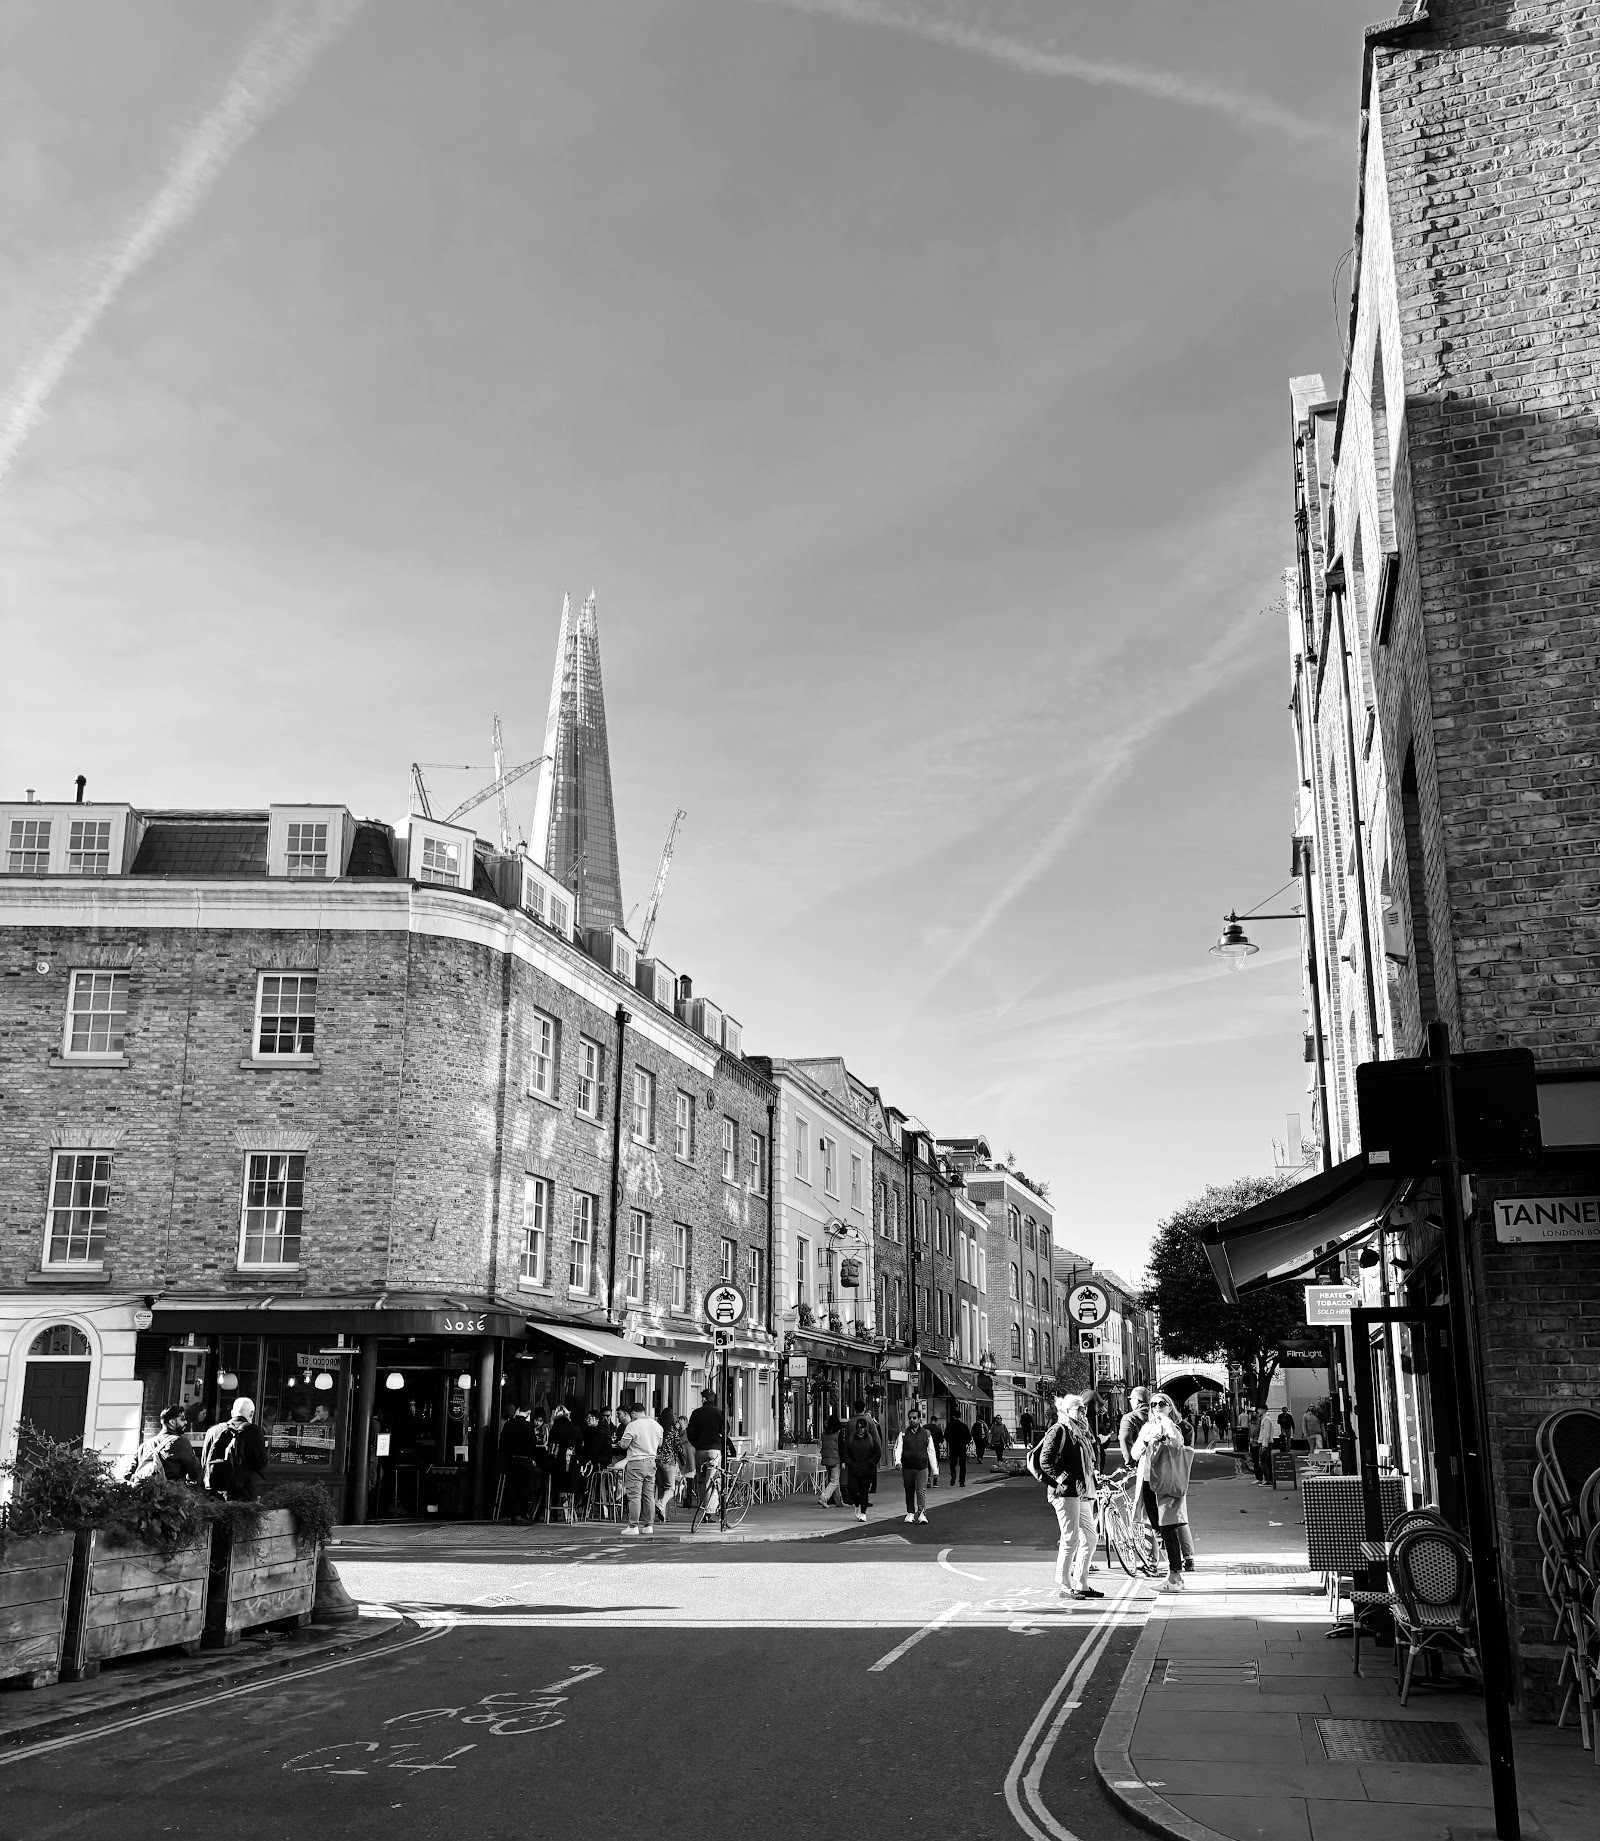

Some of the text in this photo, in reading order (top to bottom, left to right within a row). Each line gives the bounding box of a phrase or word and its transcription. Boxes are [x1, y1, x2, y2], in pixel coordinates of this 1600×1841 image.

[1500, 1202, 1600, 1226] TANNE
[1542, 1229, 1584, 1237] LONDON
[444, 1313, 488, 1331] JOSÉ
